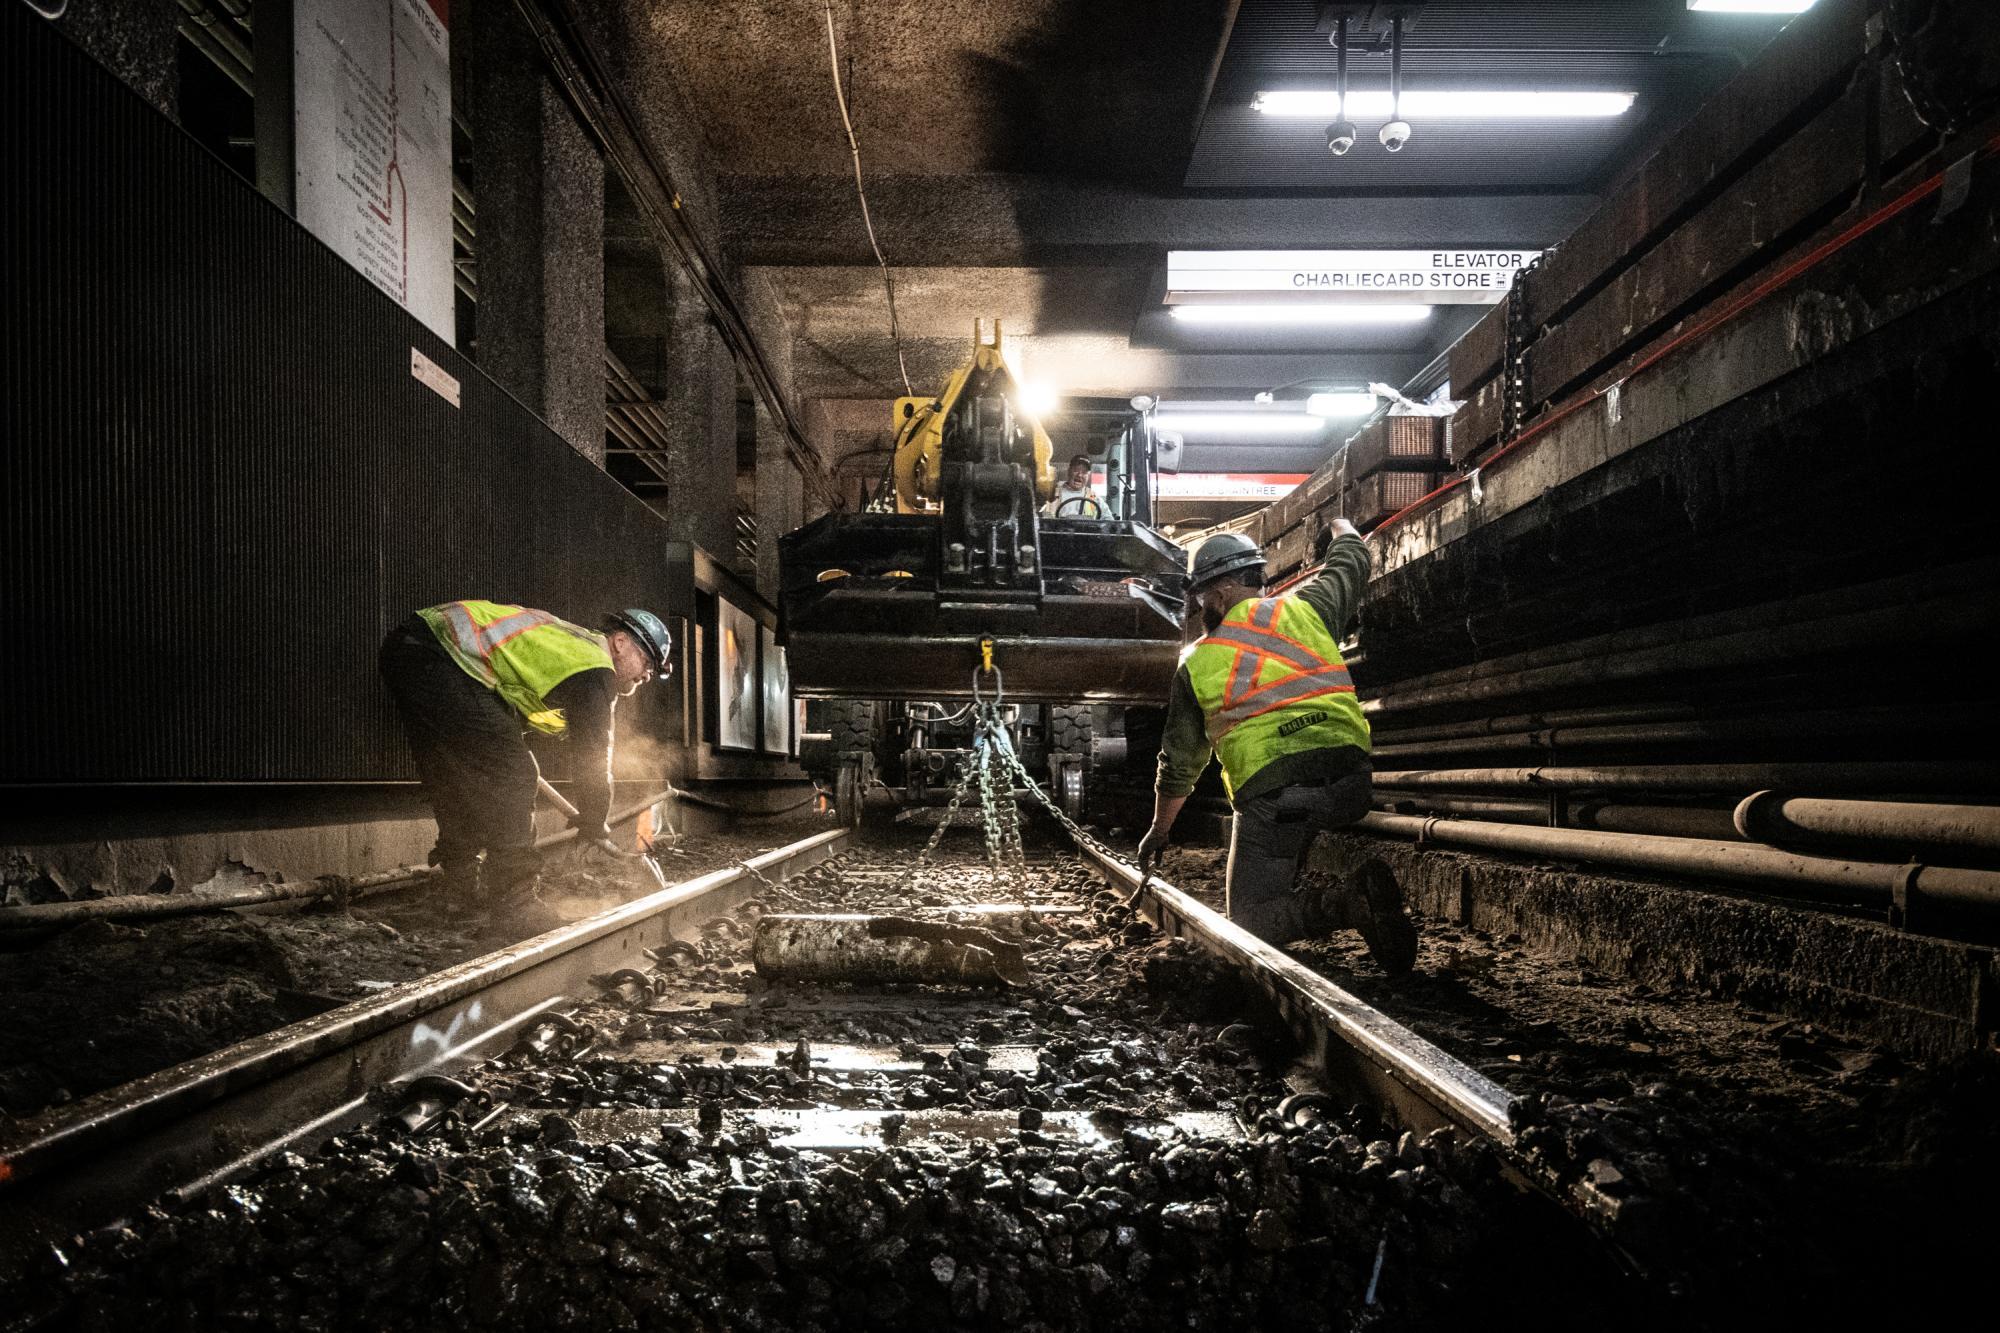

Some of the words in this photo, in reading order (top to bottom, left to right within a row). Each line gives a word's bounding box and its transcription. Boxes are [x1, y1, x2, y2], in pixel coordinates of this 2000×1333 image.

[1432, 254, 1523, 268] ELEVATOR
[1293, 273, 1424, 287] CHARLIECARD
[1430, 273, 1491, 287] STORE
